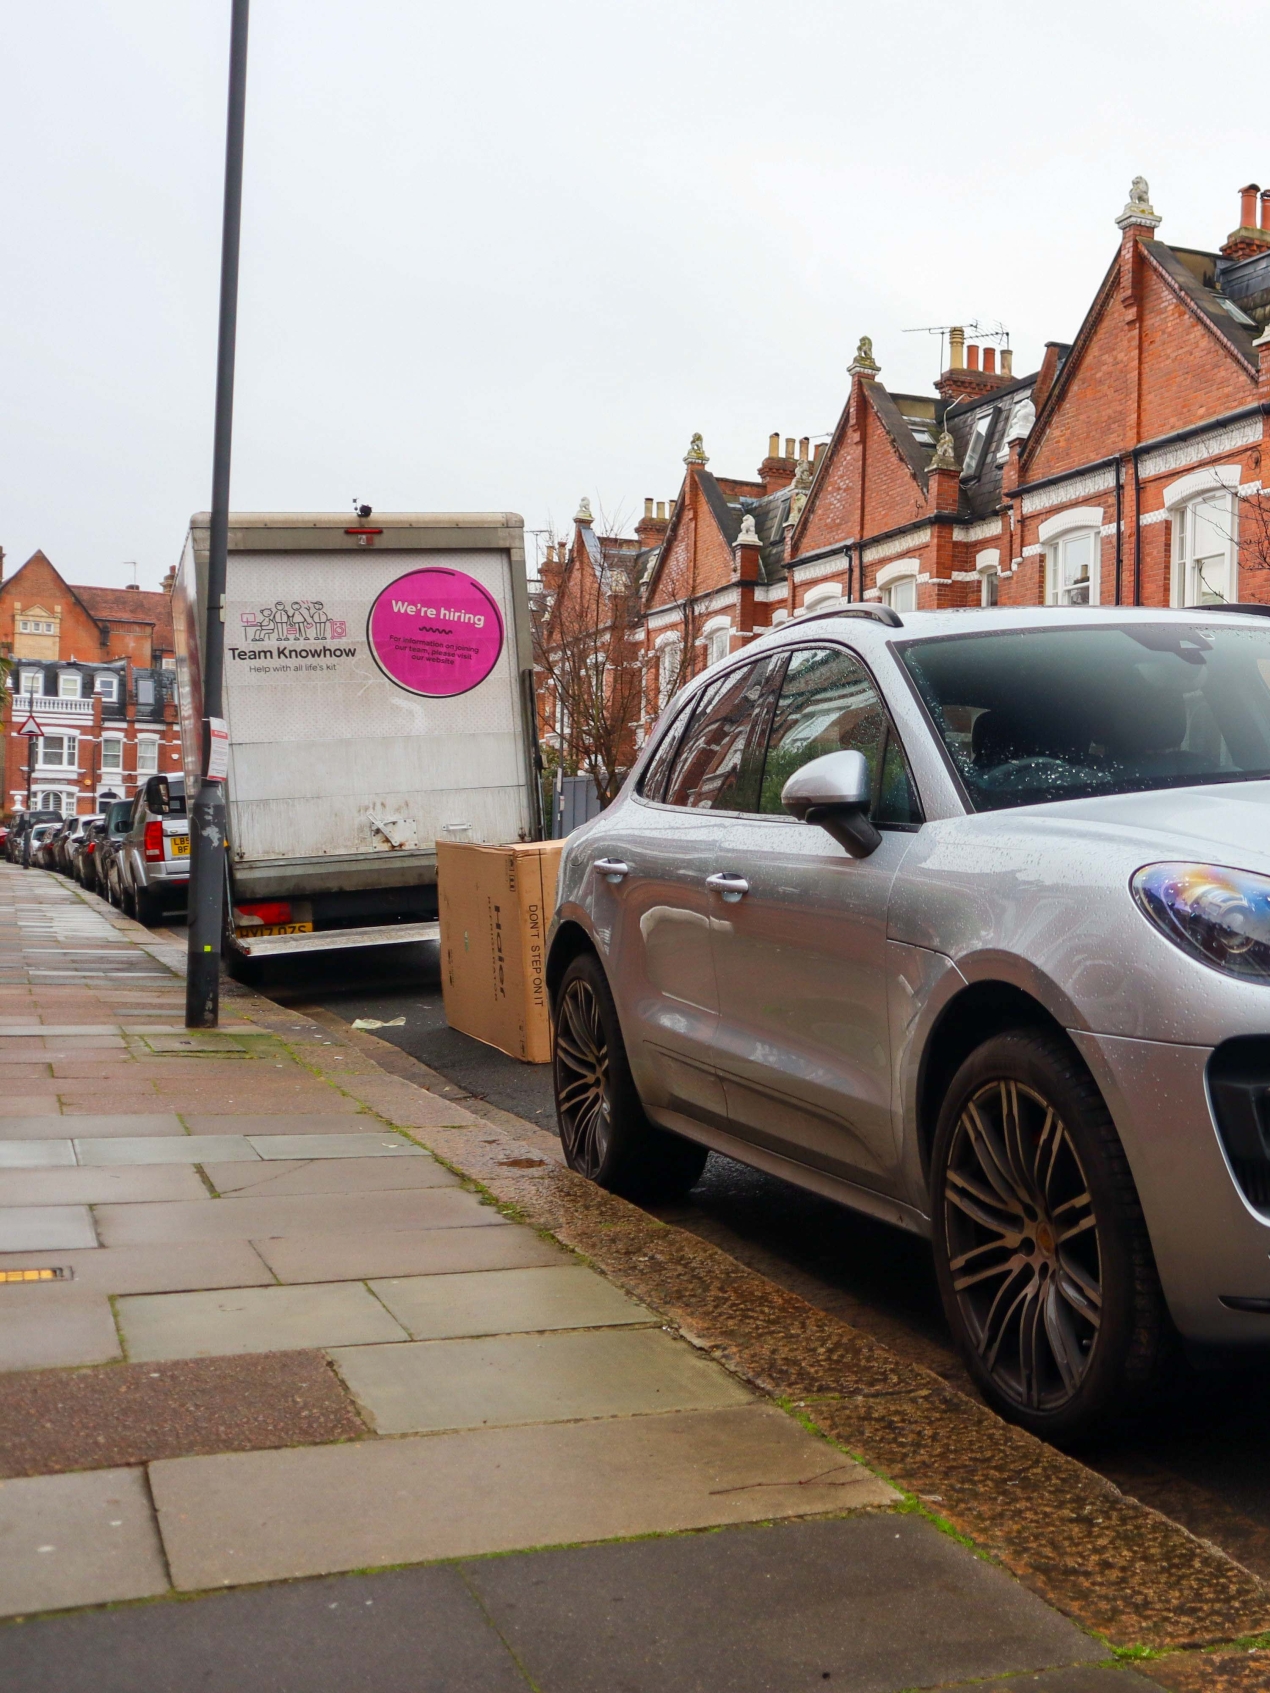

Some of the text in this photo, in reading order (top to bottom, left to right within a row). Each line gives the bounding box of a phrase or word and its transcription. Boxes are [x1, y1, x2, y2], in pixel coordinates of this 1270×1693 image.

[392, 600, 485, 628] We’re hiring
[228, 646, 357, 661] Team Knowhow
[389, 635, 402, 643] For
[403, 637, 444, 649] information
[455, 645, 480, 655] joining
[408, 645, 430, 655] team,
[431, 649, 456, 658] please
[249, 663, 337, 674] Help with all life’s kit
[426, 655, 455, 665] website
[494, 905, 506, 1000] Haier
[528, 904, 544, 1007] DON'T STEP ON IT
